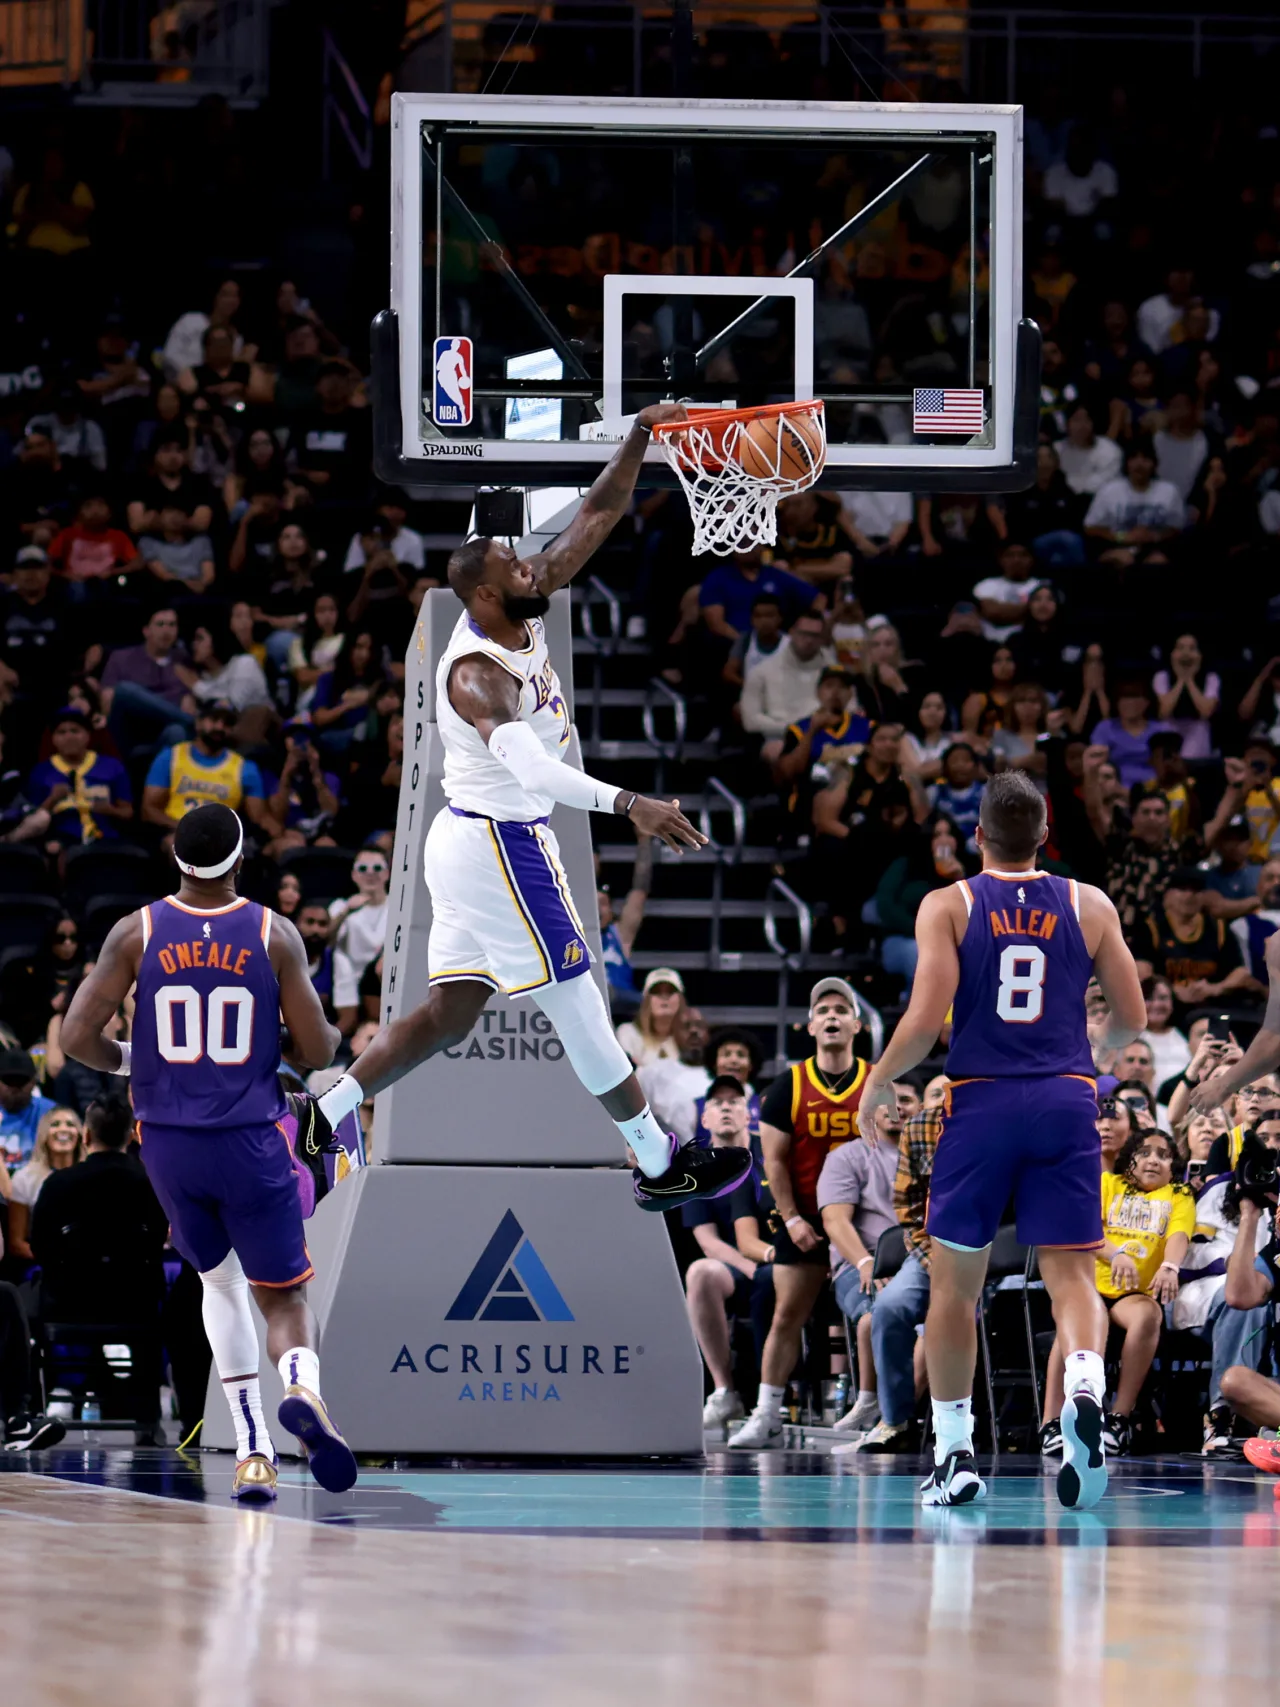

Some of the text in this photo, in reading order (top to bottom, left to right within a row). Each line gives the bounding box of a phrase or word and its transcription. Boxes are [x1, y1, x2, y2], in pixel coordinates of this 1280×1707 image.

[438, 405, 459, 421] NBA
[422, 443, 484, 458] SPALDING
[990, 907, 1058, 940] ALLEN
[157, 940, 253, 976] O'NEALE
[995, 943, 1049, 1024] 8
[154, 984, 255, 1066] 00
[457, 1381, 562, 1402] ARENA
